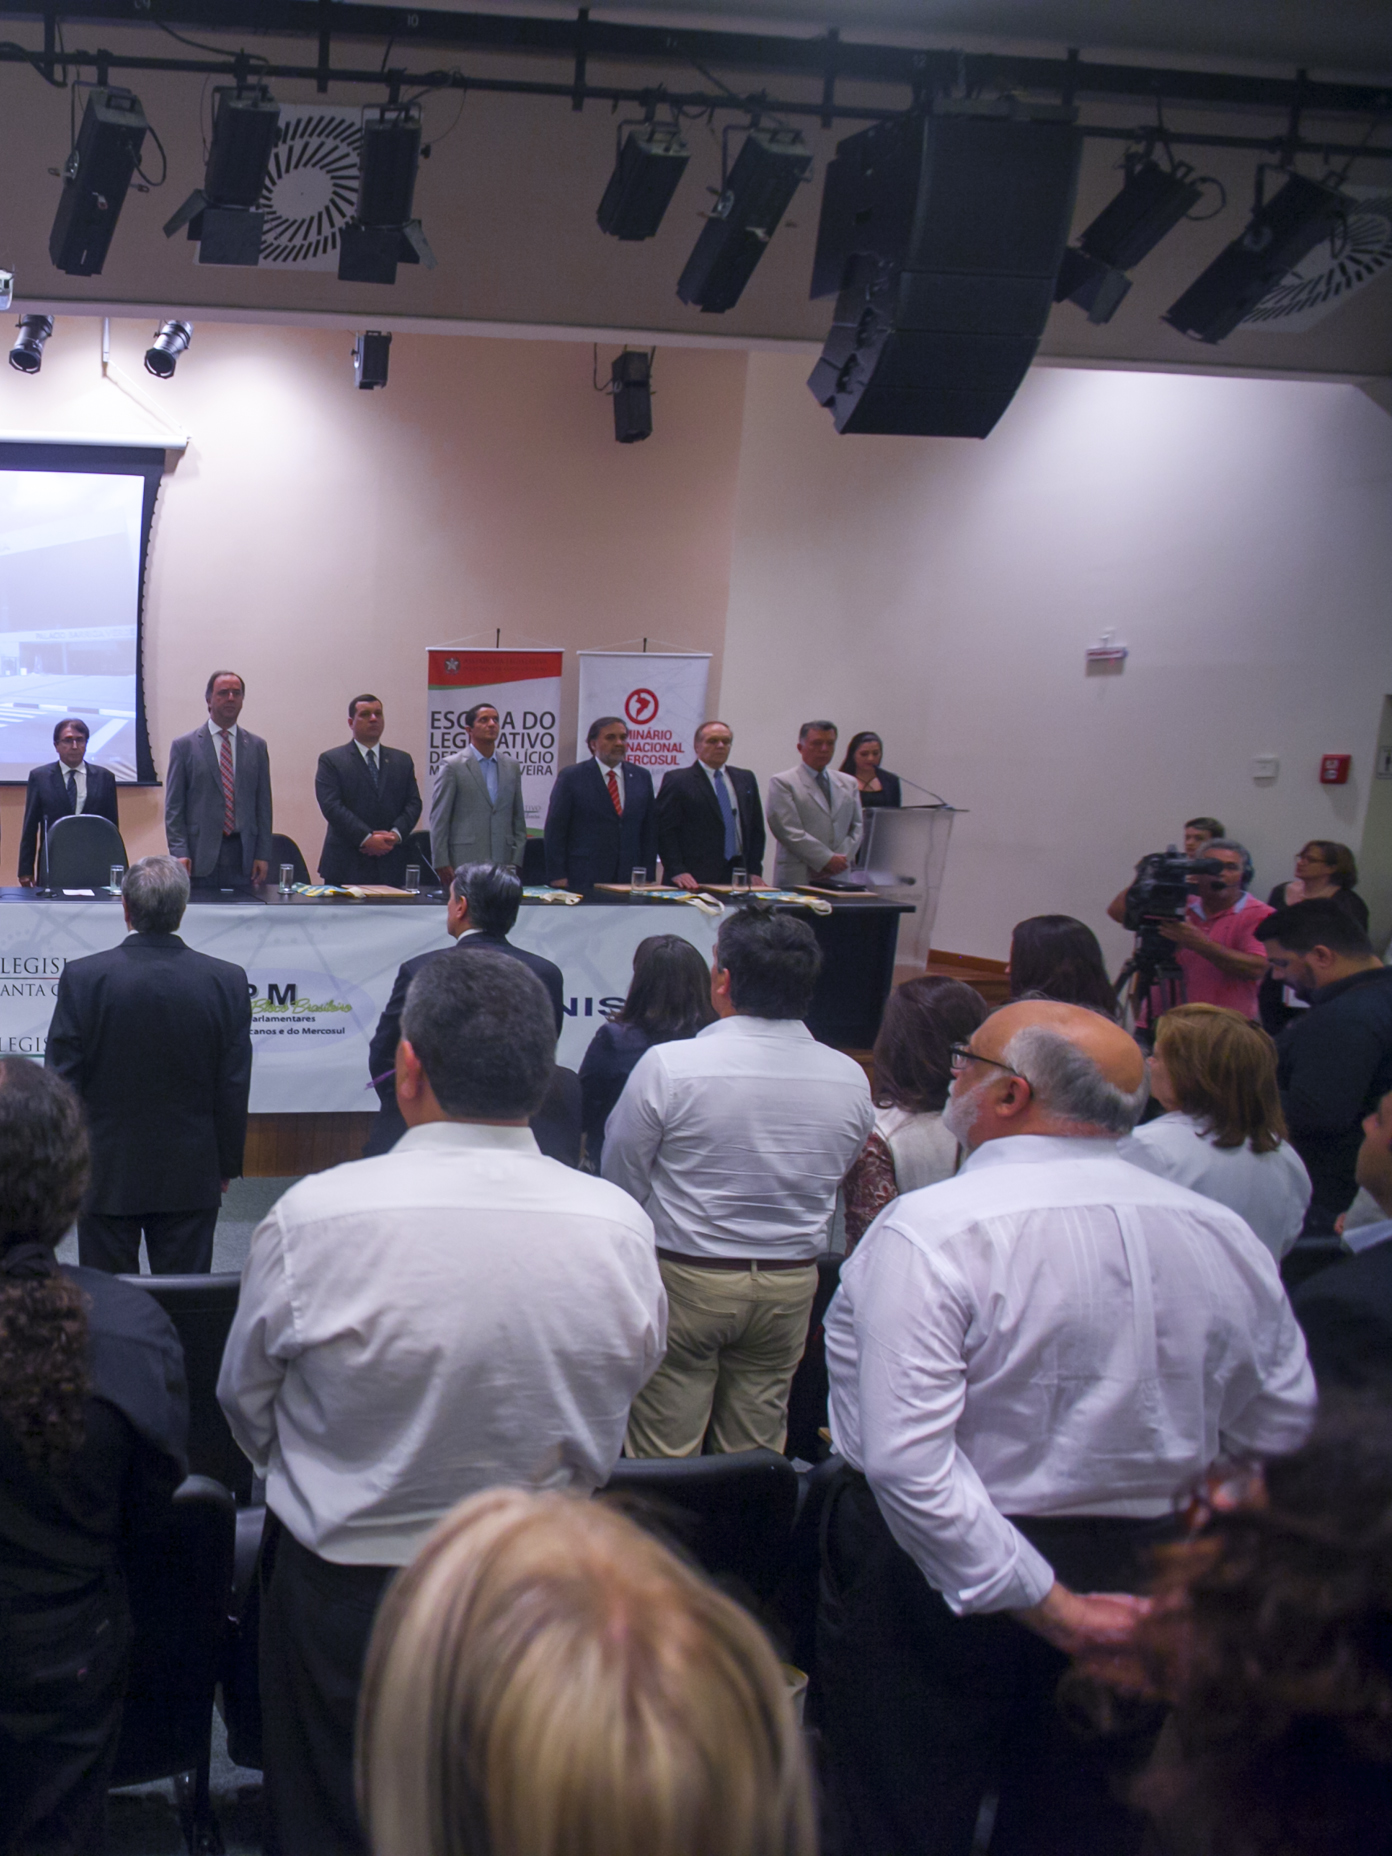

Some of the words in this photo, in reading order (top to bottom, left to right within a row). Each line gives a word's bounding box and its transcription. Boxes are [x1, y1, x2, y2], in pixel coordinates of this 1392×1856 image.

[407, 13, 420, 28] 10
[431, 711, 515, 730] ESCA
[523, 711, 556, 730] DO
[625, 742, 685, 753] NACIONAL
[626, 755, 680, 766] ERCOSUL
[520, 765, 553, 776] VEIRA
[252, 1015, 316, 1023] arlamentares
[302, 1027, 345, 1035] Mercosul
